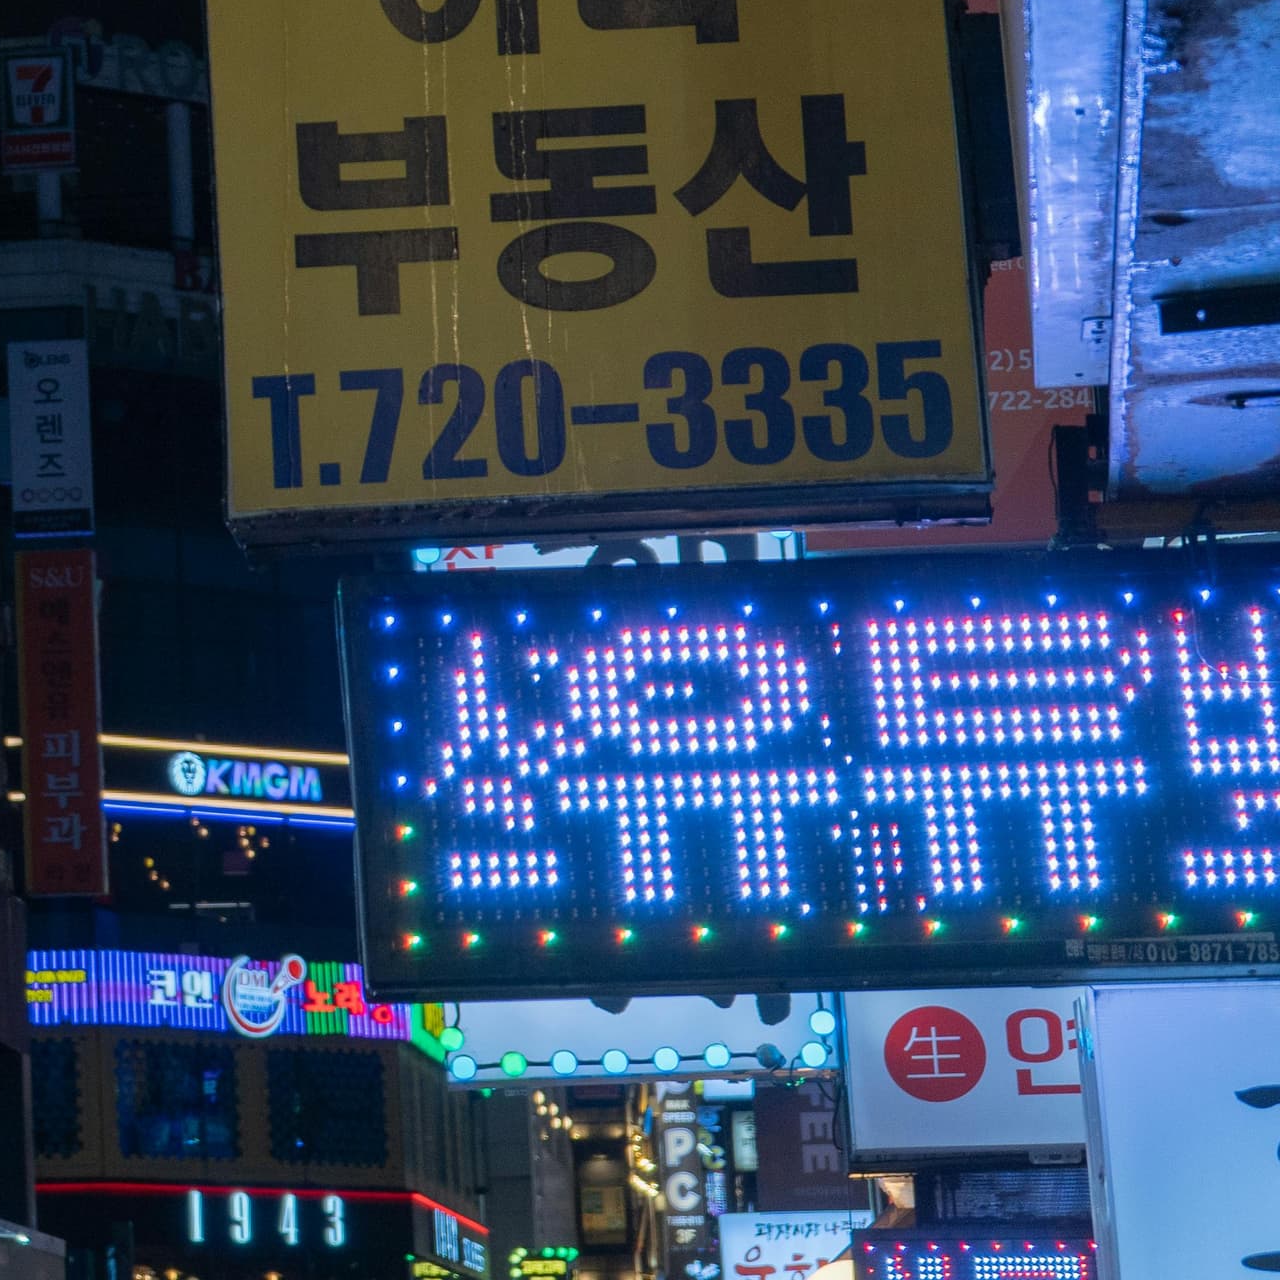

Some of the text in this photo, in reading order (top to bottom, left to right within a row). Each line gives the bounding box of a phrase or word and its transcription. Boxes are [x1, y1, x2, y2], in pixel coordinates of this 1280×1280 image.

[295, 94, 868, 317] 부동산
[33, 378, 67, 478] 오렌즈
[252, 340, 955, 489] T.720-3335
[30, 567, 85, 589] S&U
[42, 729, 87, 850] 피부과
[206, 758, 323, 802] KMGM
[147, 969, 213, 1008] 코인
[904, 1026, 967, 1080] 生
[663, 1127, 702, 1212] PC
[188, 1190, 345, 1246] 1943
